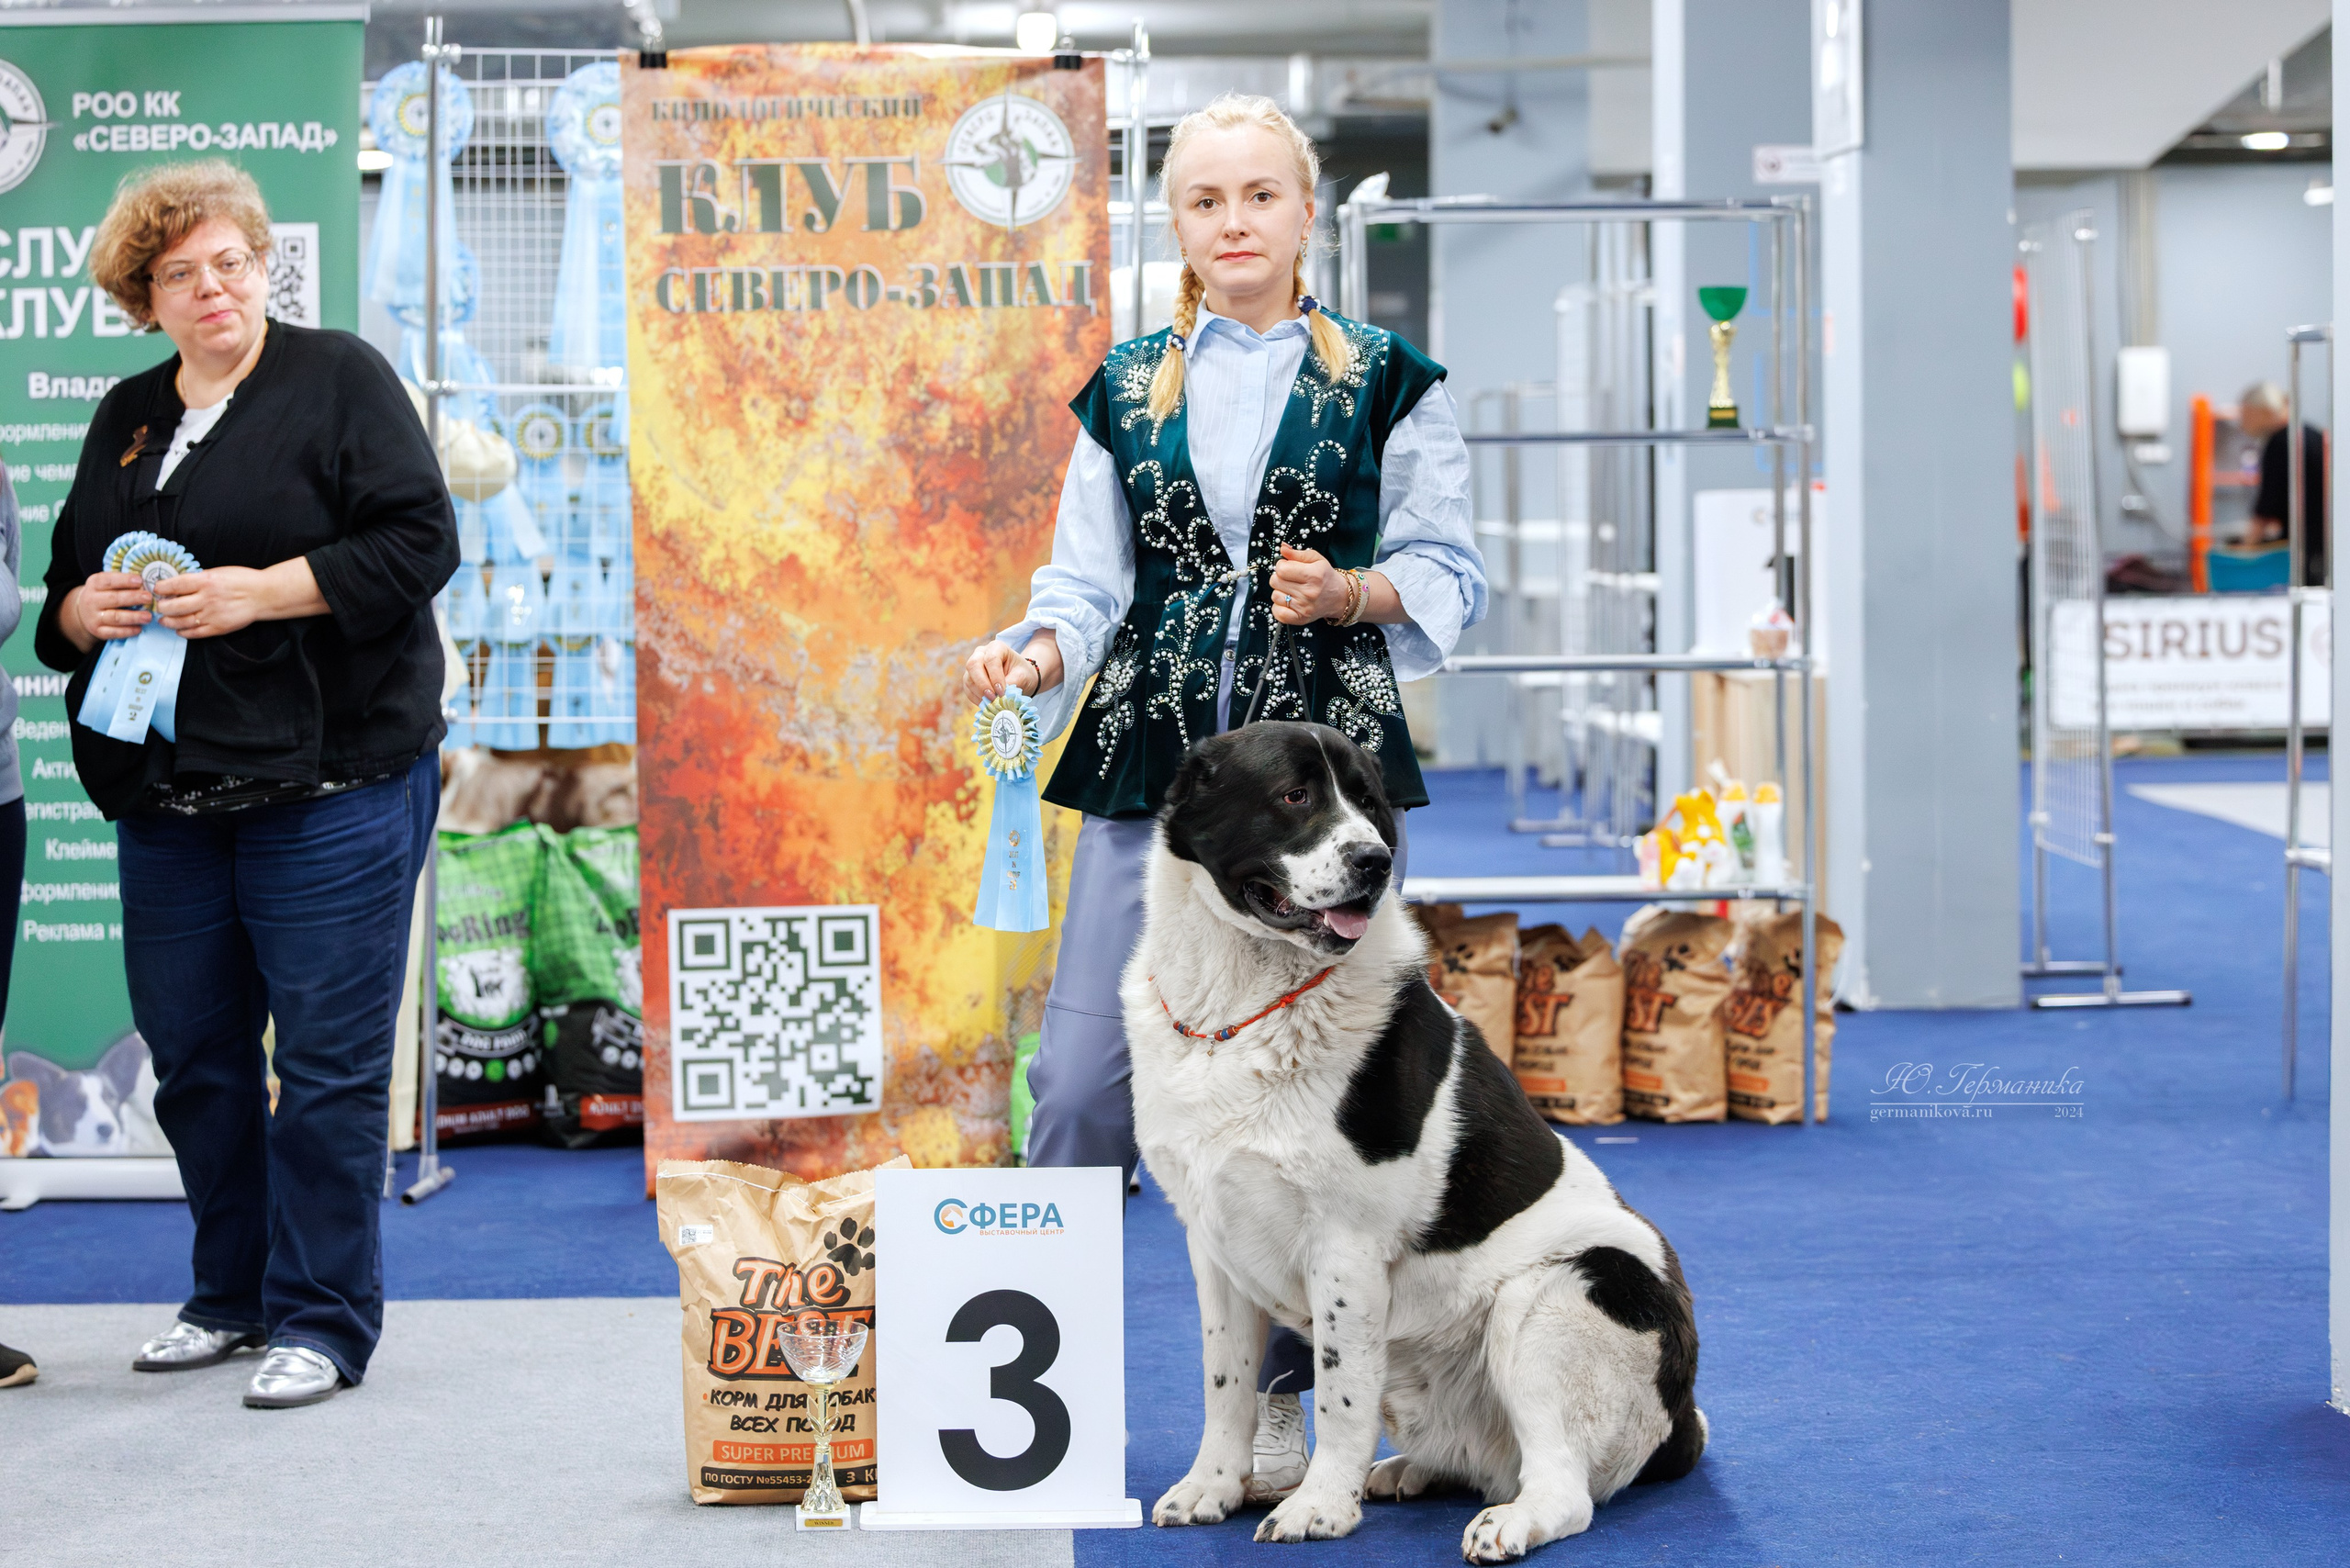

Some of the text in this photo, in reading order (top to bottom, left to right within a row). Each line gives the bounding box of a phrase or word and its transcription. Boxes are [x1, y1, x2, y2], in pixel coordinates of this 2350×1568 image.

[72, 90, 182, 119] РОО КК
[73, 122, 338, 154] «СЕВЕРО-ЗАПАД»
[654, 154, 927, 235] КЛУБ
[655, 259, 1097, 316] СЕВЕРО-ЗАПАД
[2104, 617, 2286, 662] SIRIUS
[934, 1198, 1064, 1235] СФЕРА
[979, 1227, 1038, 1237] ВЫСТАВОЧНЫЙ
[733, 1257, 851, 1313] The
[711, 1387, 877, 1411] КОРМ ДЛЯ ОБАК
[938, 1289, 1071, 1491] 3
[730, 1415, 779, 1432] ВСЕХ
[721, 1443, 865, 1462] SUPER PREIUM
[705, 1473, 718, 1483] ПО
[721, 1473, 754, 1484] ГОСТУ
[756, 1474, 812, 1484] №55453-2
[845, 1471, 856, 1484] 3
